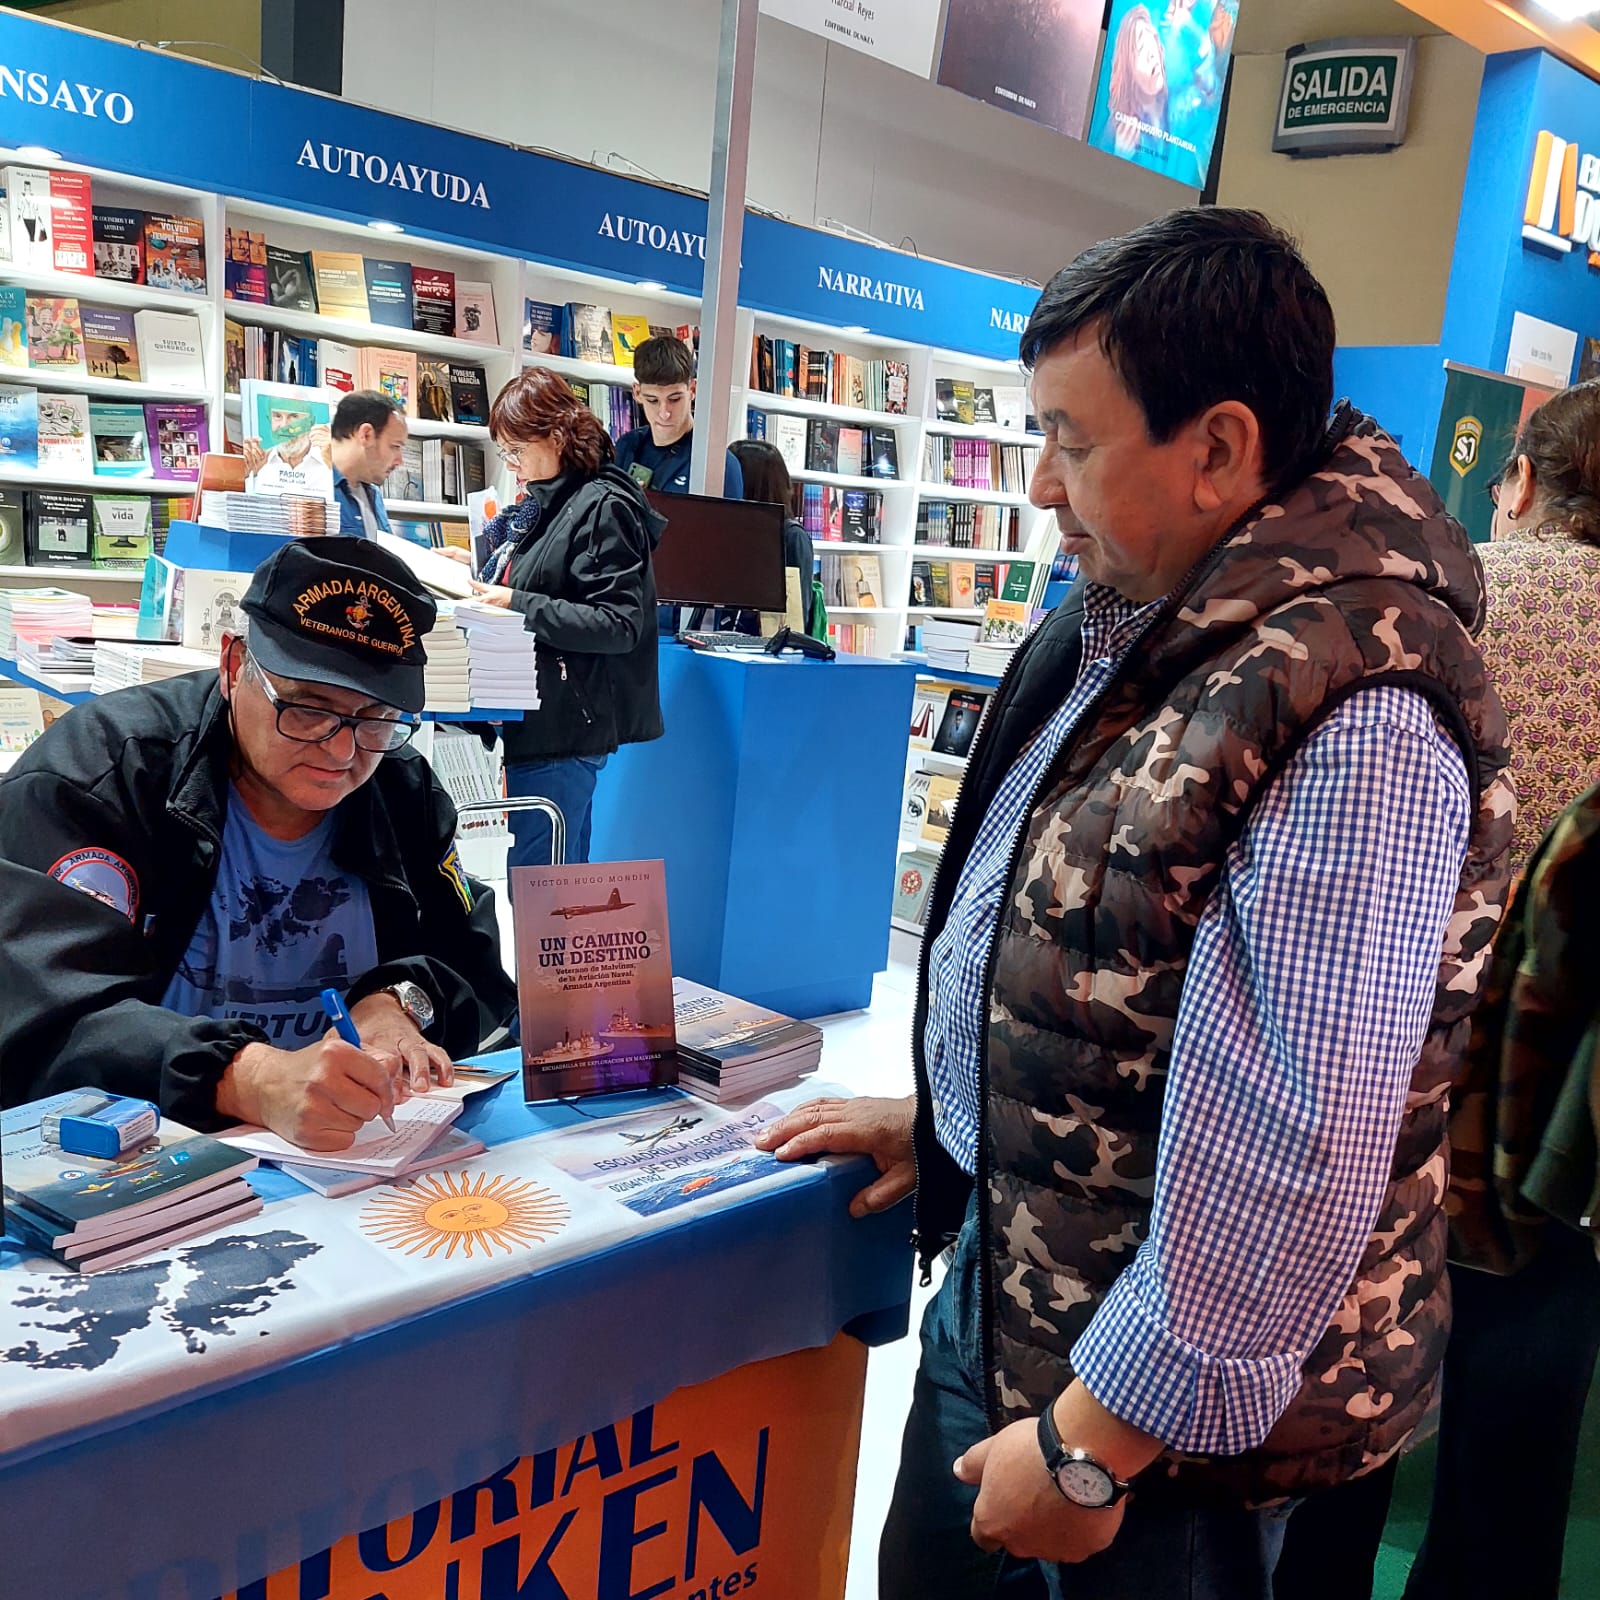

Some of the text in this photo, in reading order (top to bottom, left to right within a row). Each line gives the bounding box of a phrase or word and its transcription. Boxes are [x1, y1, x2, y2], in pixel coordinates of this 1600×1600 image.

[857, 3, 875, 20] Reyes
[824, 19, 875, 45] EDITORIAL DUNKEN
[1291, 66, 1388, 102] SALIDA
[1288, 102, 1386, 119] DE EMERGENCIA
[296, 139, 491, 210] AUTOAYUDA
[161, 222, 189, 234] VOLVER
[598, 212, 709, 260] AUTOAYU
[415, 284, 451, 294] CRYPTO
[817, 266, 925, 311] NARRATIVA
[112, 507, 134, 520] vida
[292, 578, 416, 649] ARMADA ARGENTINA
[300, 615, 404, 656] VETERANOS DE GUERRA
[70, 851, 110, 865] ARMADA
[574, 876, 604, 885] HUGO
[540, 930, 648, 952] UN CAMINO
[538, 945, 651, 967] UN DESTINO
[555, 967, 589, 976] Veterano
[600, 962, 637, 971] Malvinas,
[558, 975, 569, 983] de
[577, 972, 610, 981] Aviación
[562, 979, 631, 991] Armada Argentina
[223, 1009, 334, 1039] PTU
[633, 1053, 662, 1062] MALVINAS
[593, 1141, 691, 1172] ESCUADRILLA
[689, 1121, 755, 1150] AERONAL
[639, 1136, 751, 1175] DE EXPLORAIÓN
[608, 1174, 665, 1193] 02/04/182
